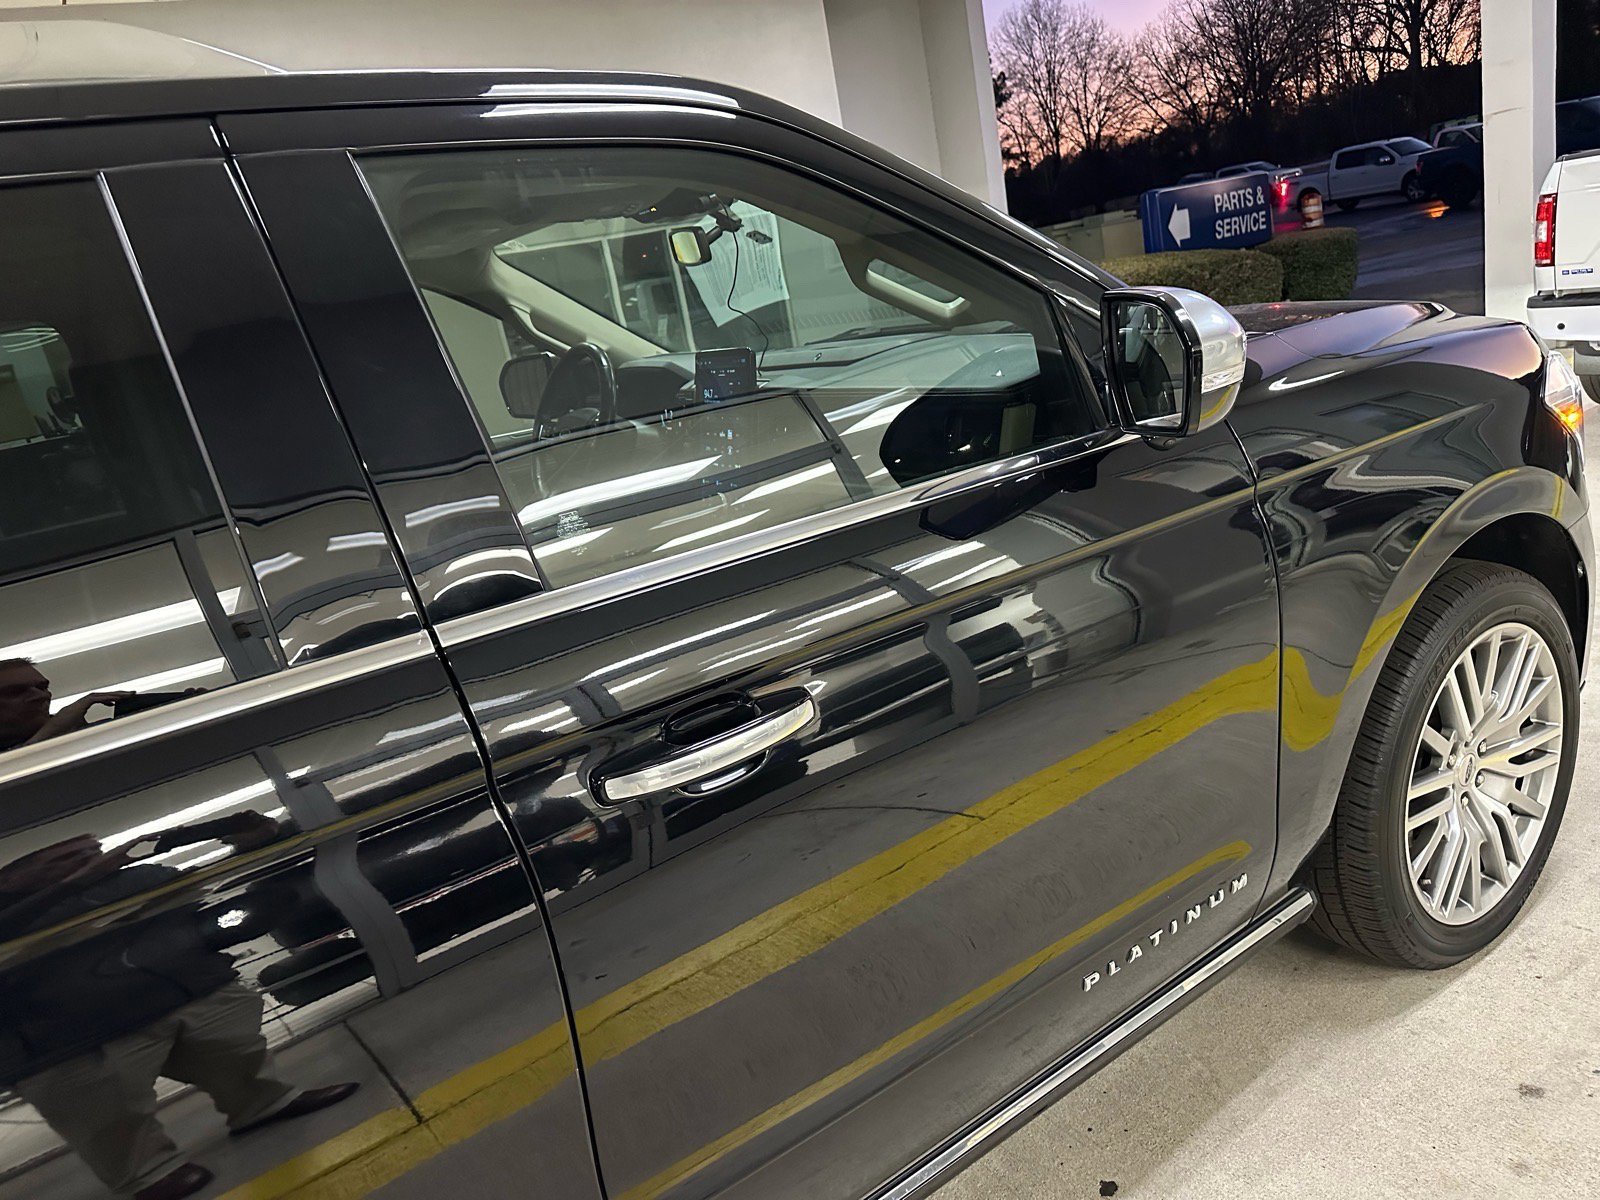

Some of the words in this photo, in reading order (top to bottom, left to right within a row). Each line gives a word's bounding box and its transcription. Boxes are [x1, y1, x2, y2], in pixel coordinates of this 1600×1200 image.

[1214, 188, 1253, 213] PARTS
[1256, 185, 1264, 204] &
[1215, 211, 1266, 239] SERVICE
[1082, 873, 1248, 992] PLATINUM
